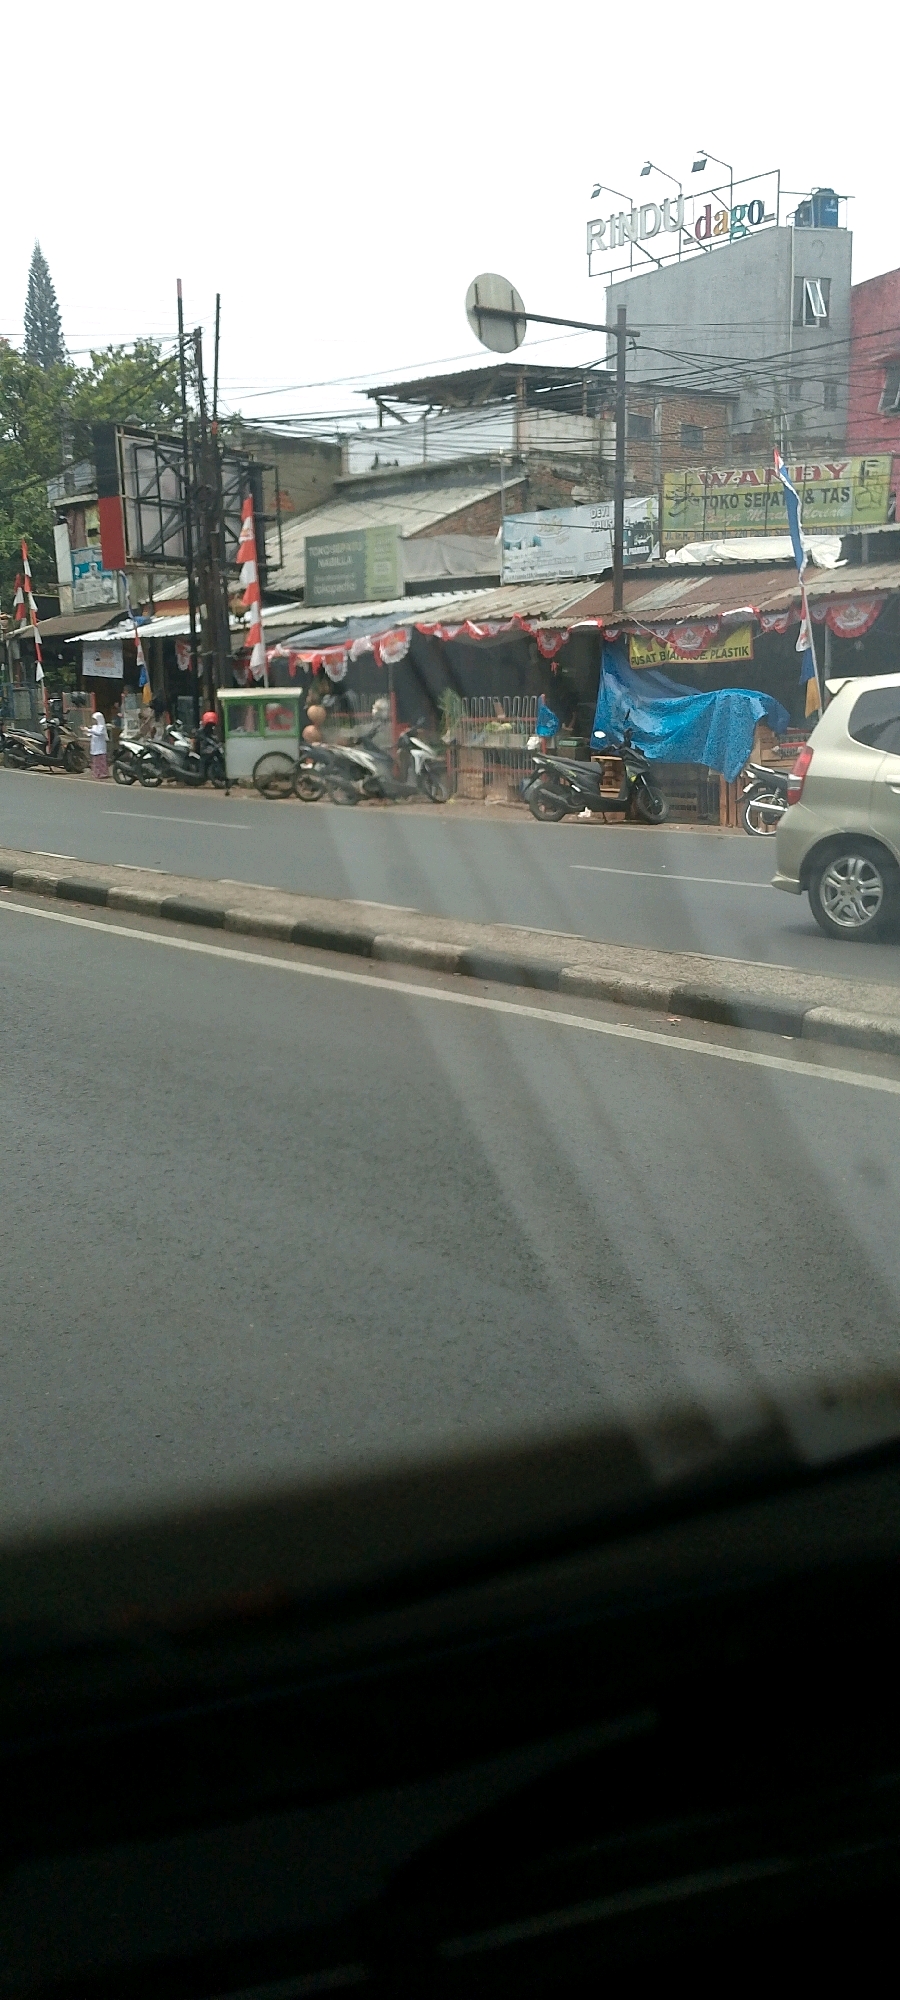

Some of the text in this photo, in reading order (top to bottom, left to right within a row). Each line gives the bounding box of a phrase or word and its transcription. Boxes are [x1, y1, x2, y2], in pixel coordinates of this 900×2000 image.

[586, 193, 765, 255] RINDU dago
[703, 493, 739, 510] TOKO
[805, 488, 815, 504] &
[821, 486, 850, 504] TAS
[710, 646, 749, 660] PLASTIK
